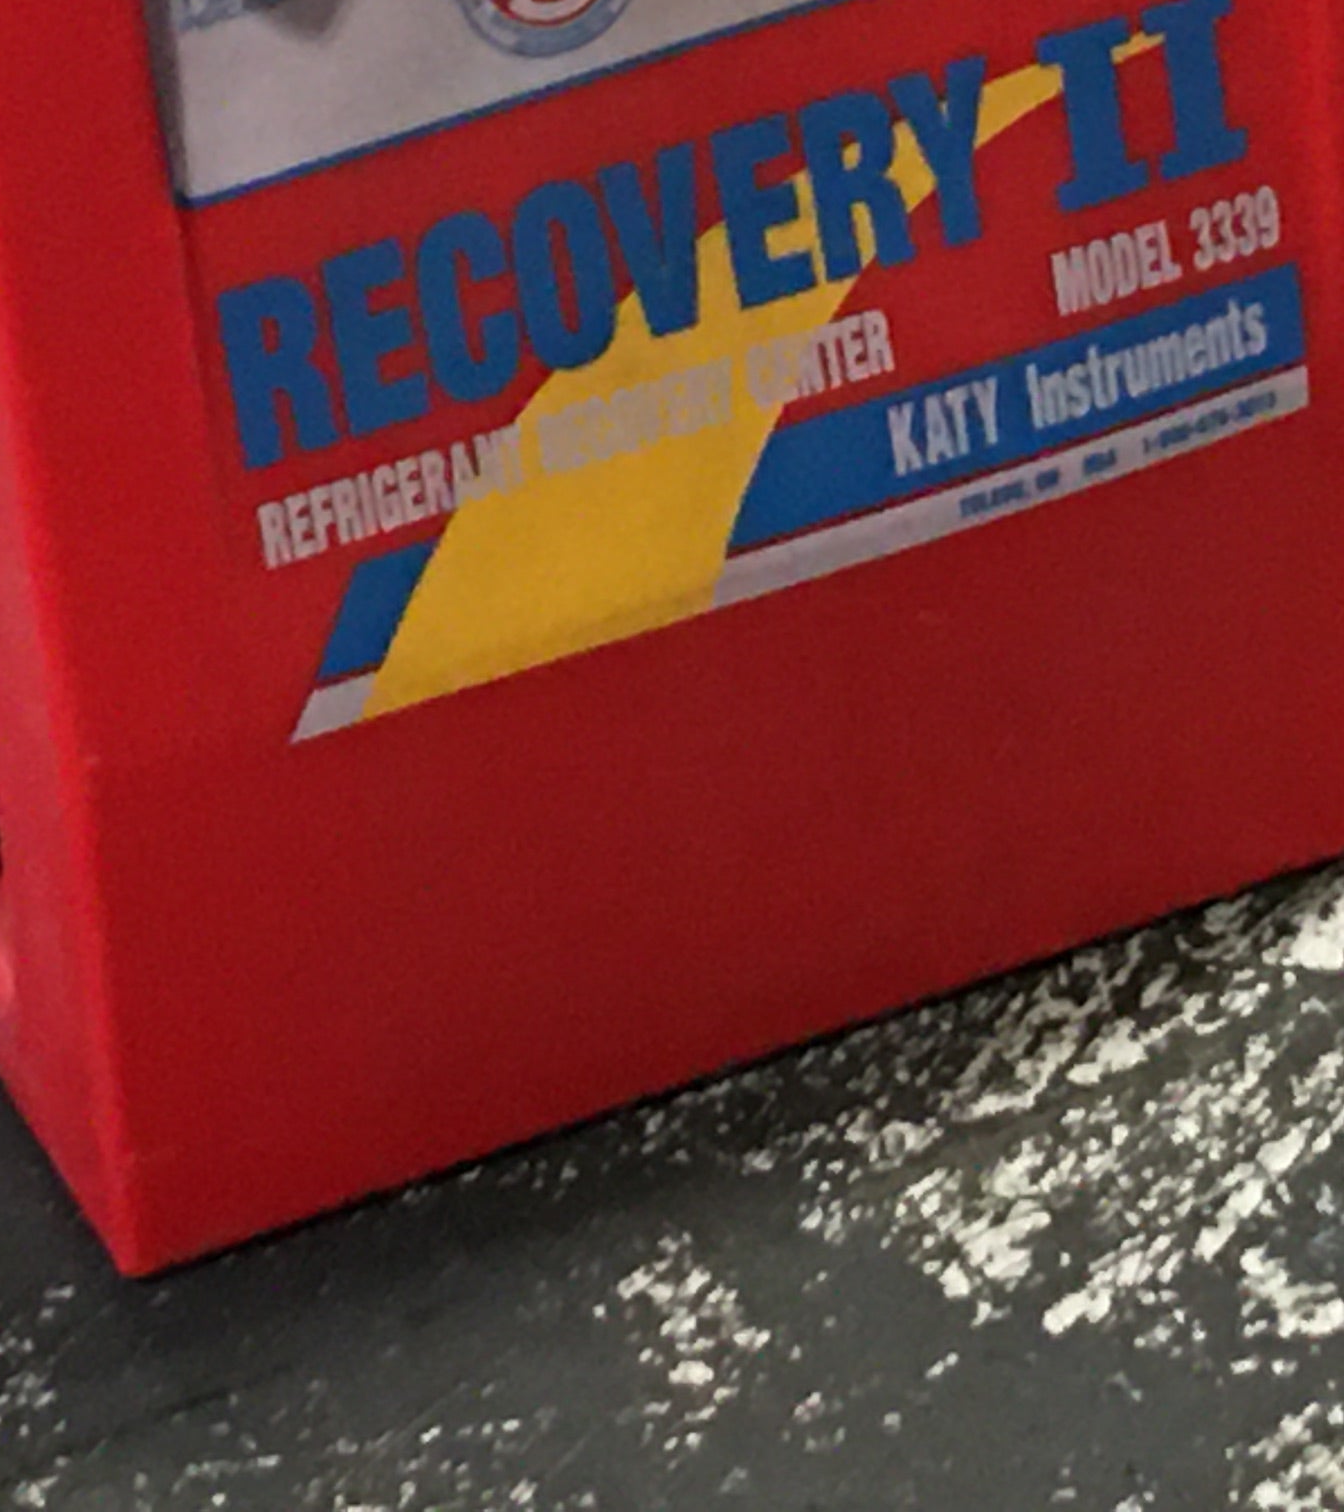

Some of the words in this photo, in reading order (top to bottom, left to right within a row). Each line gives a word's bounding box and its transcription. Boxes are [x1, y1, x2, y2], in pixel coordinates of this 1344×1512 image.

[219, 55, 987, 470] RECOVERY
[1051, 220, 1182, 316] MODEL
[1189, 185, 1280, 271] 3339
[258, 422, 524, 570] REFRIGERANT
[536, 357, 736, 472] RECOVERY
[747, 308, 895, 407] CENTER
[888, 376, 999, 477] KATY
[1026, 298, 1269, 430] Instruments
